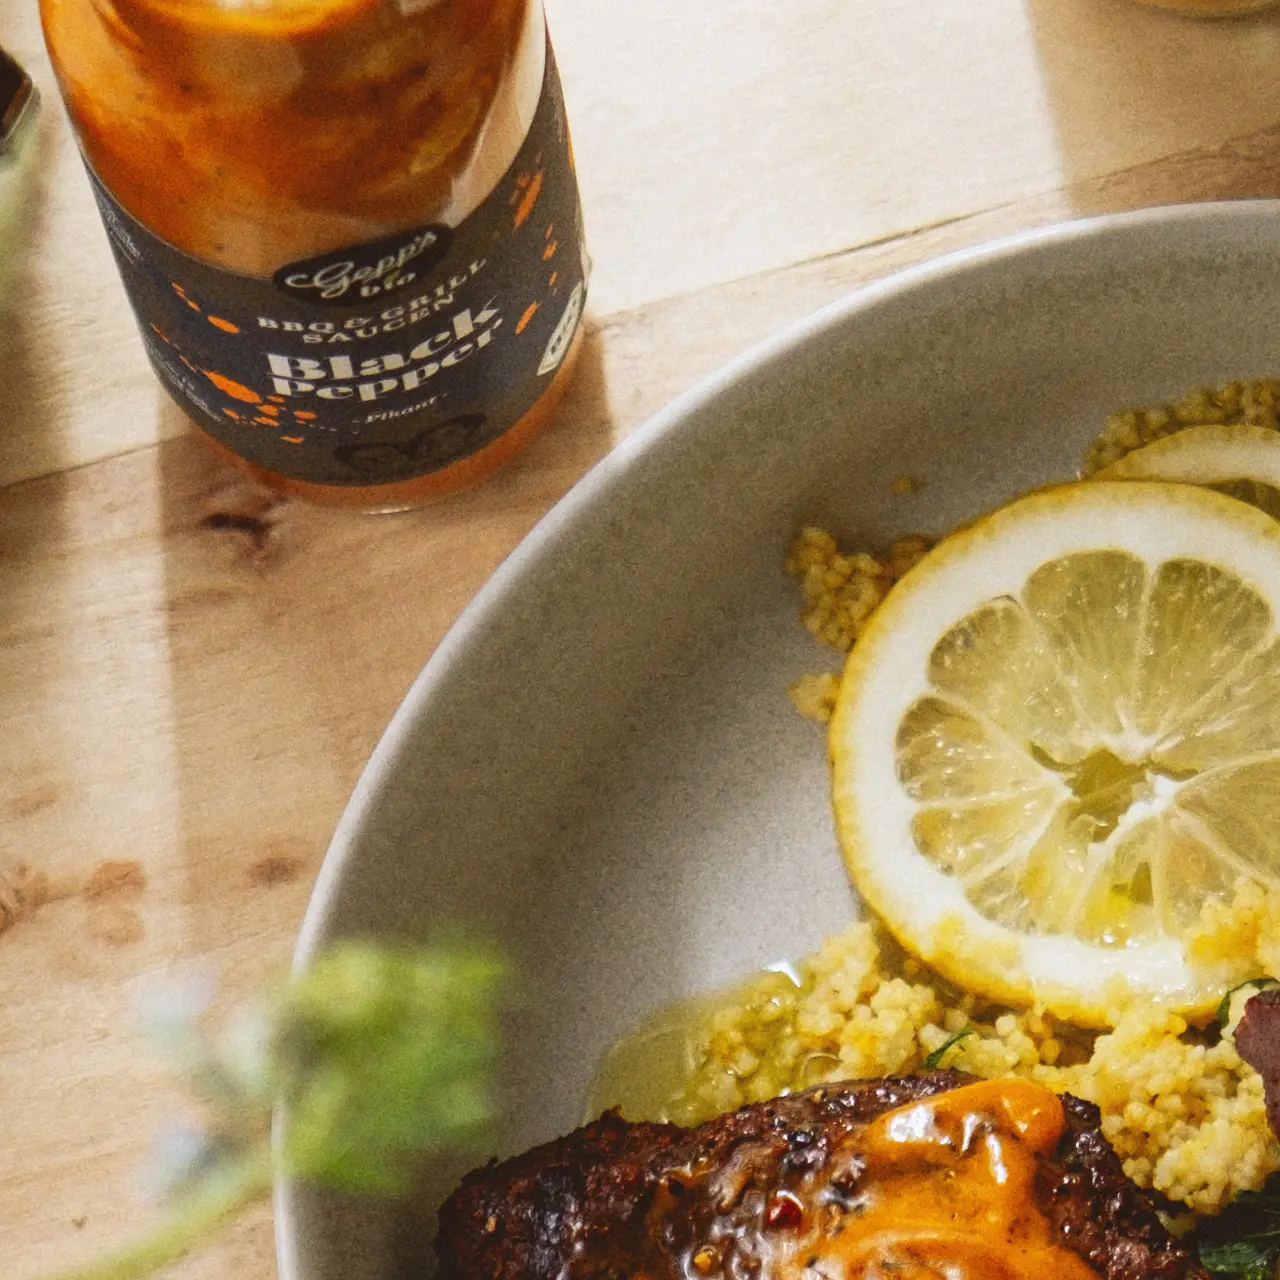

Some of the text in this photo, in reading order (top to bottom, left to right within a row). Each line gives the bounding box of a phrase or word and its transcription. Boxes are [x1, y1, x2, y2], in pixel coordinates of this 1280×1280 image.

[257, 316, 336, 334] BBQ
[381, 259, 487, 321] GRILL
[302, 292, 454, 344] SAUCEN
[261, 295, 501, 381] Black
[269, 318, 503, 402] Pepper
